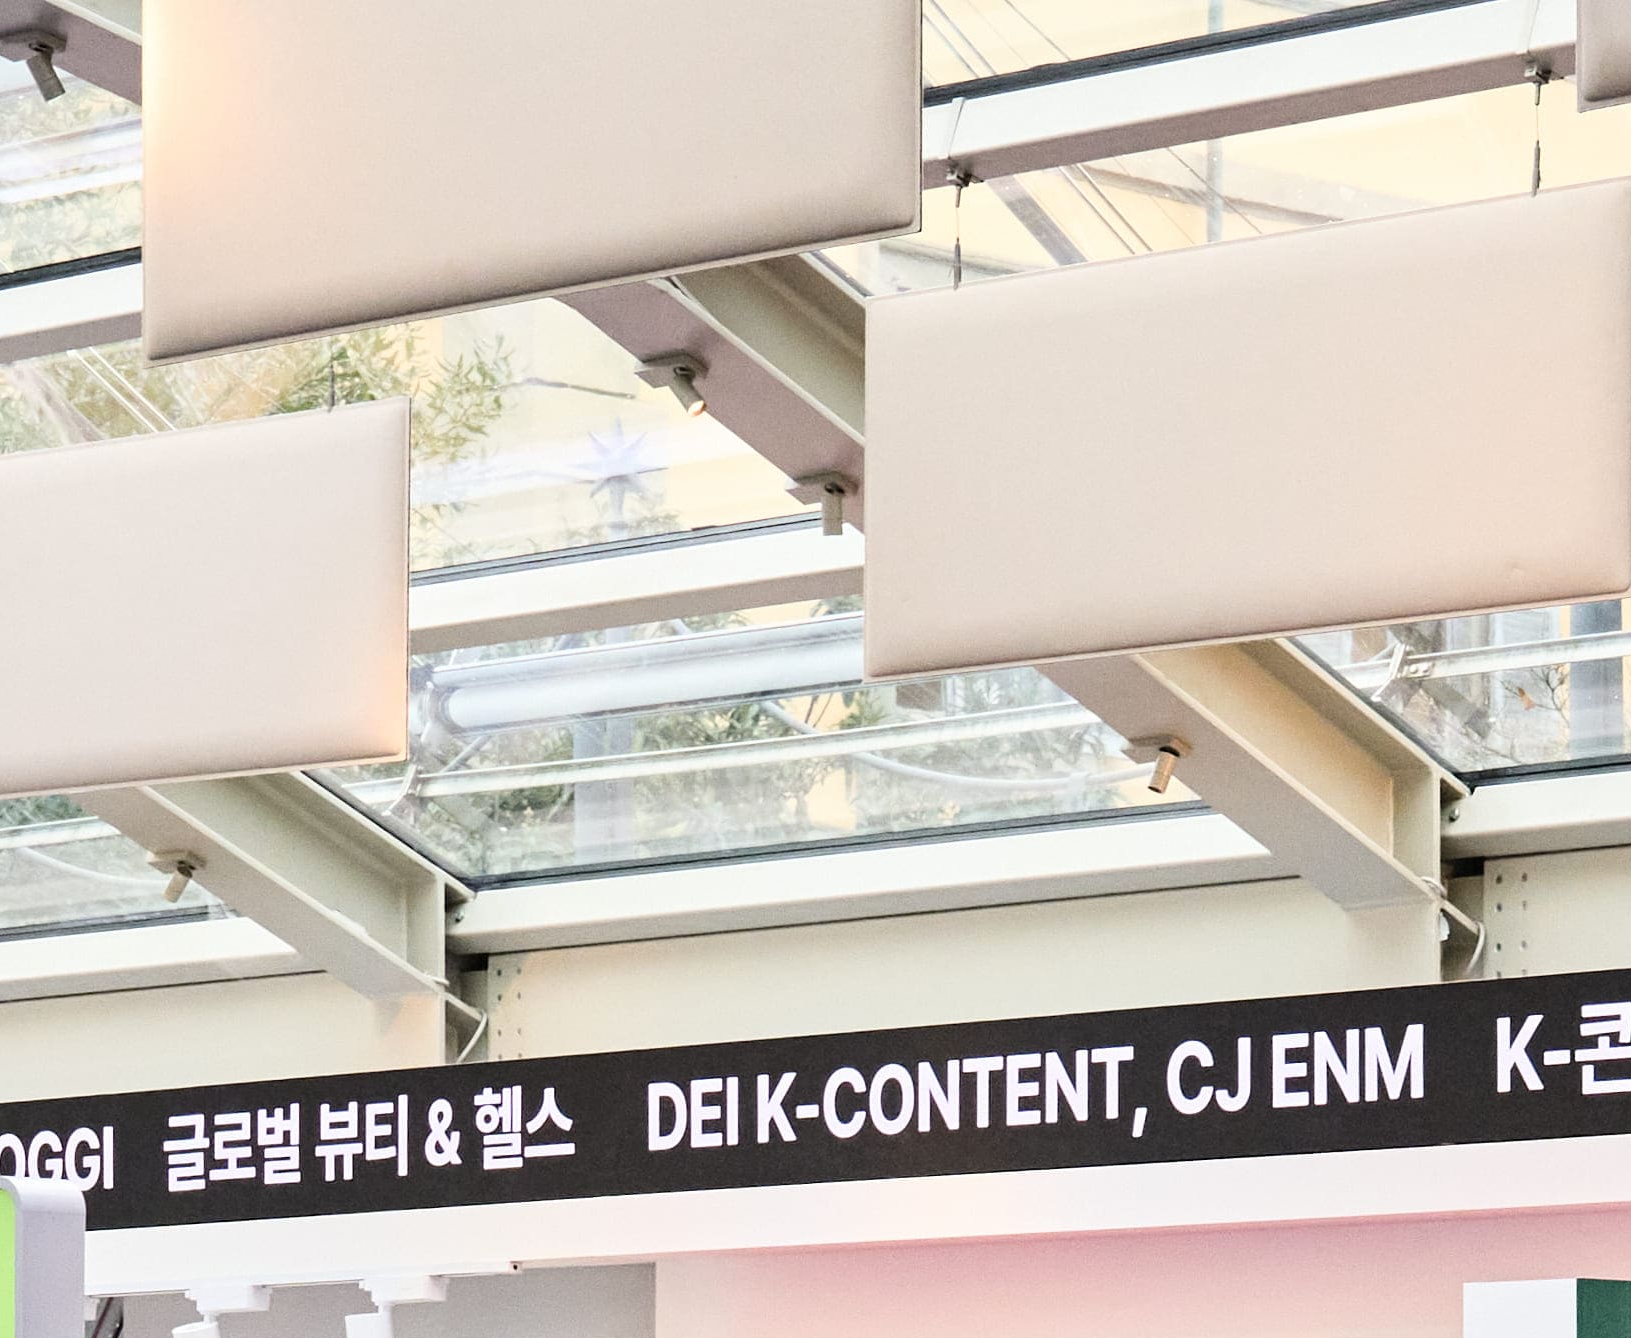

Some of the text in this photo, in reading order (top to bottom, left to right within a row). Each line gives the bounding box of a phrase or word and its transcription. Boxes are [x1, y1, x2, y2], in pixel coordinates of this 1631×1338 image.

[163, 1085, 576, 1193] 글로벌 뷰티 & 헬스
[647, 1023, 1424, 1152] DEI K-CONTENT, CJ ENM
